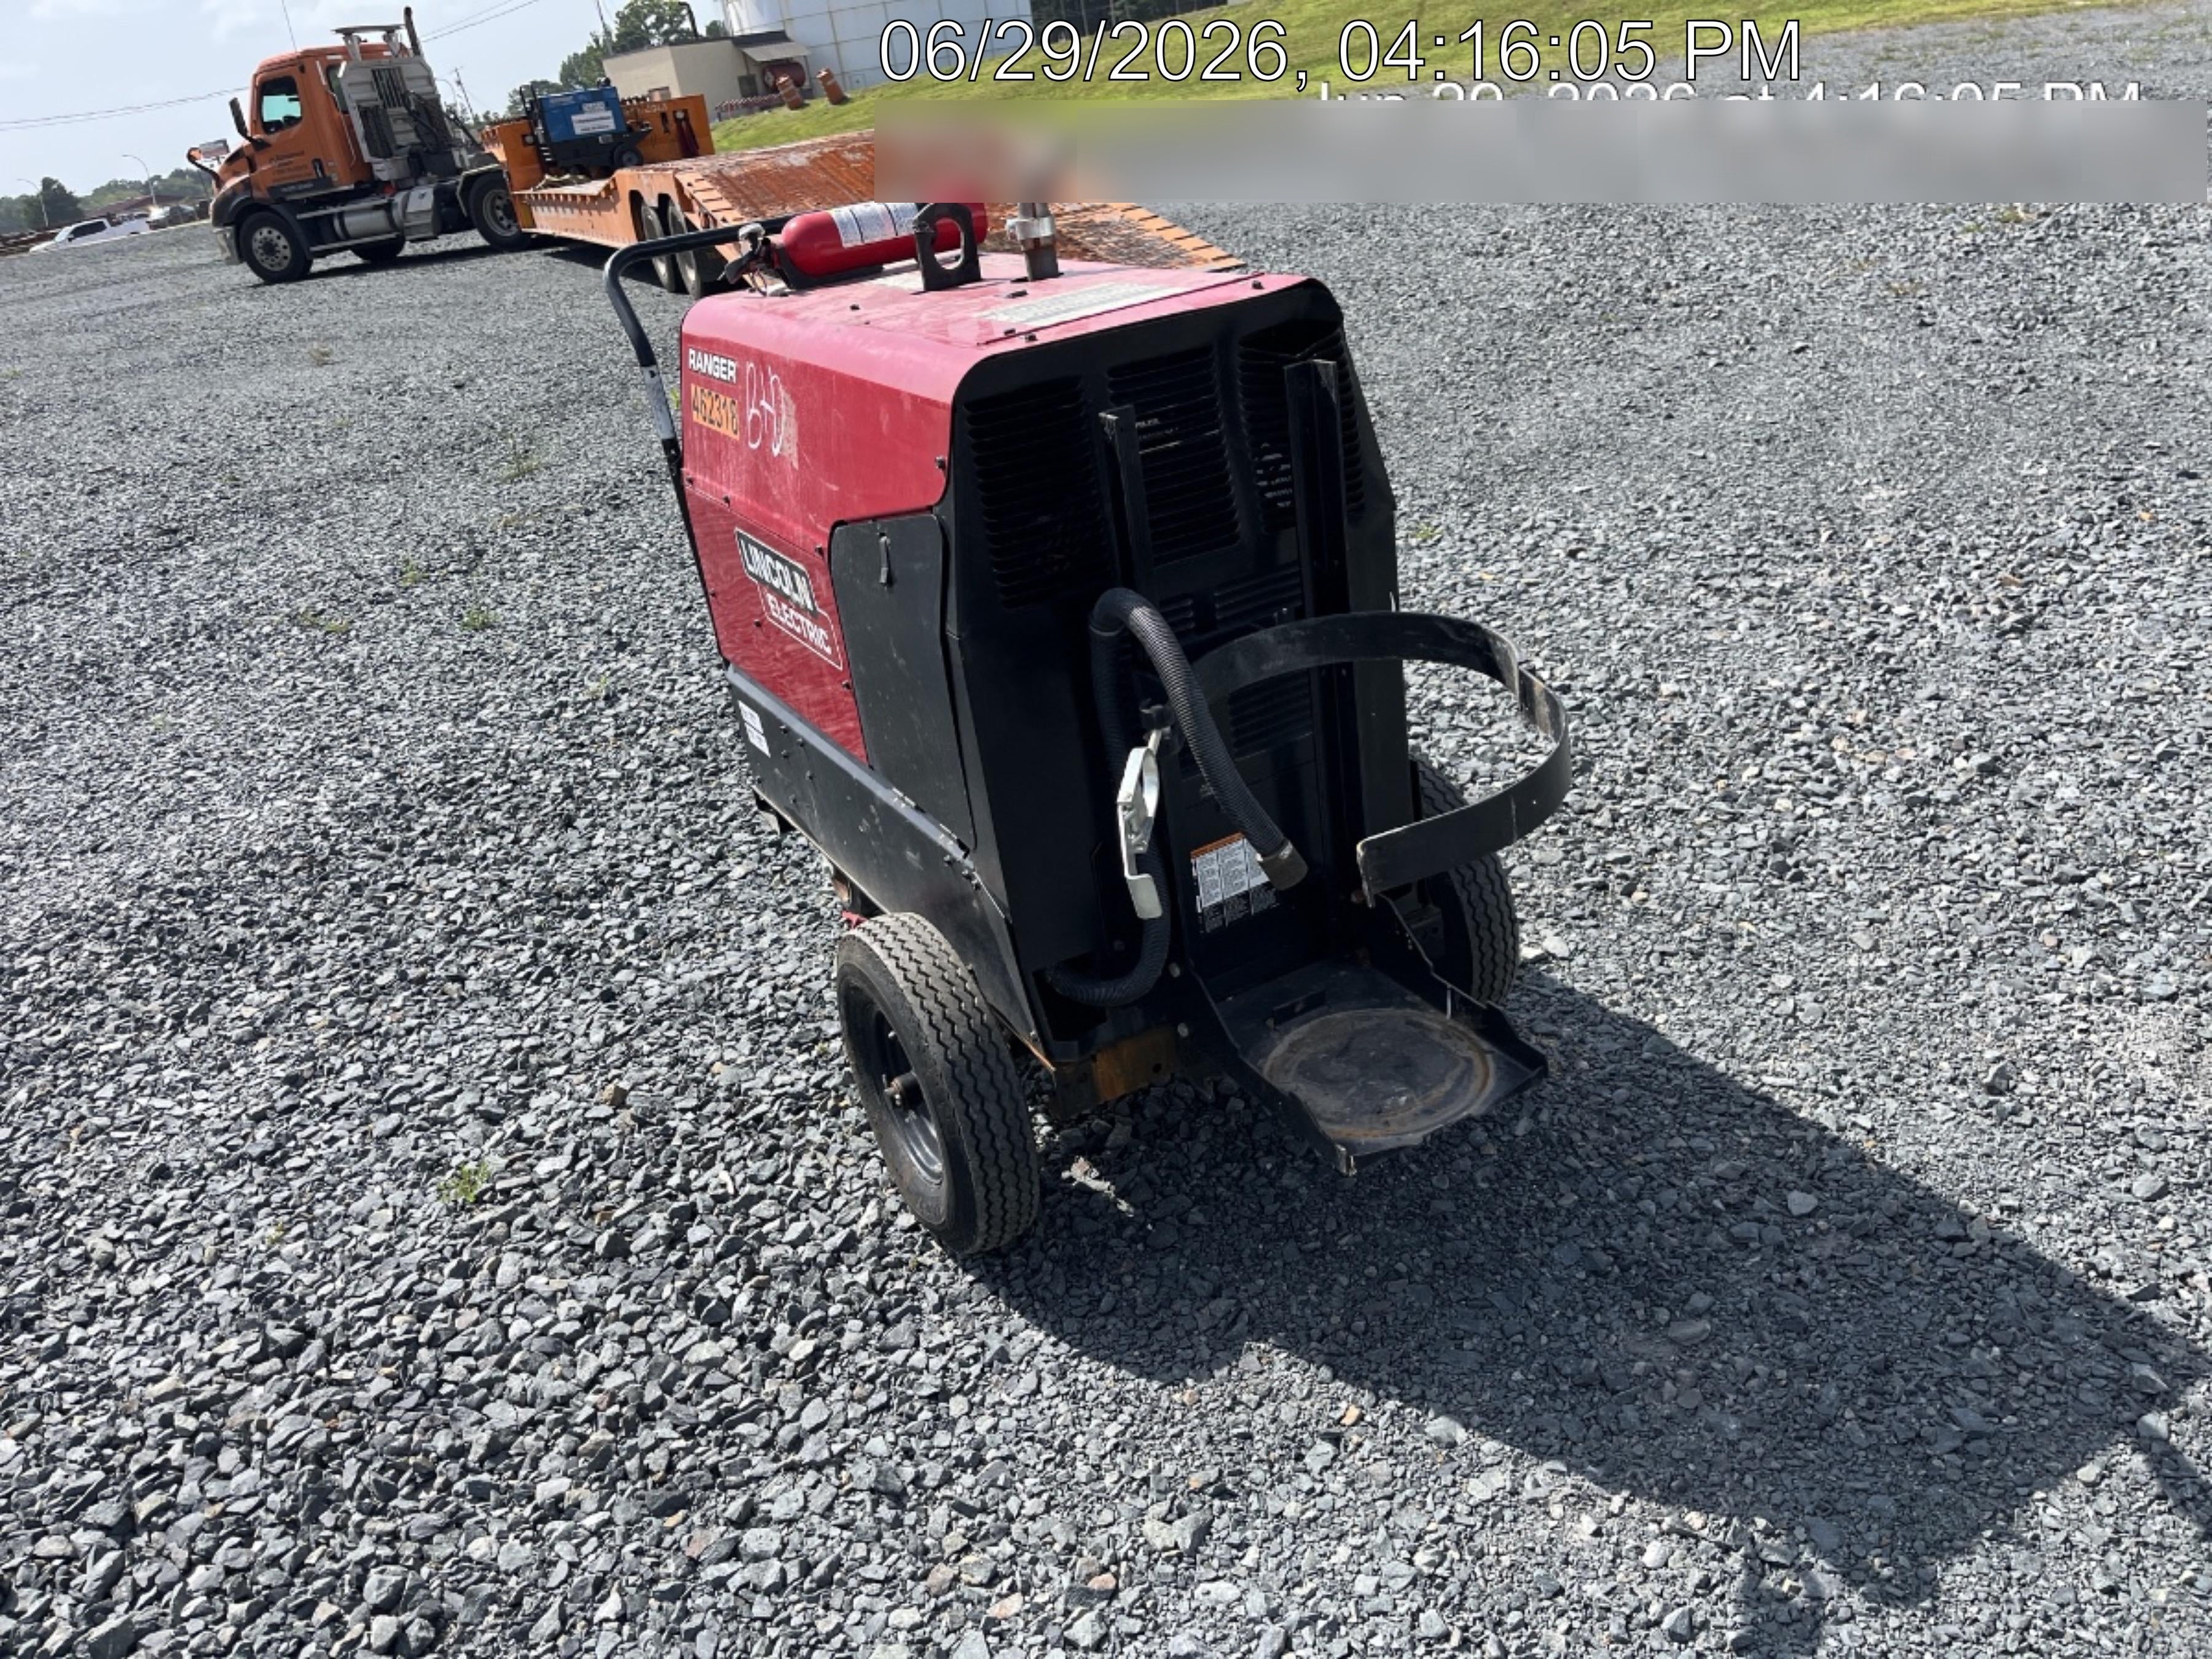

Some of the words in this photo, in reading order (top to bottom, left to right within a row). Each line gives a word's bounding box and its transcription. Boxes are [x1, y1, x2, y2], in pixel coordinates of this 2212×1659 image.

[688, 347, 737, 383] RANGER
[740, 538, 814, 611] LINCOLN
[764, 592, 832, 655] ELECTRIC
